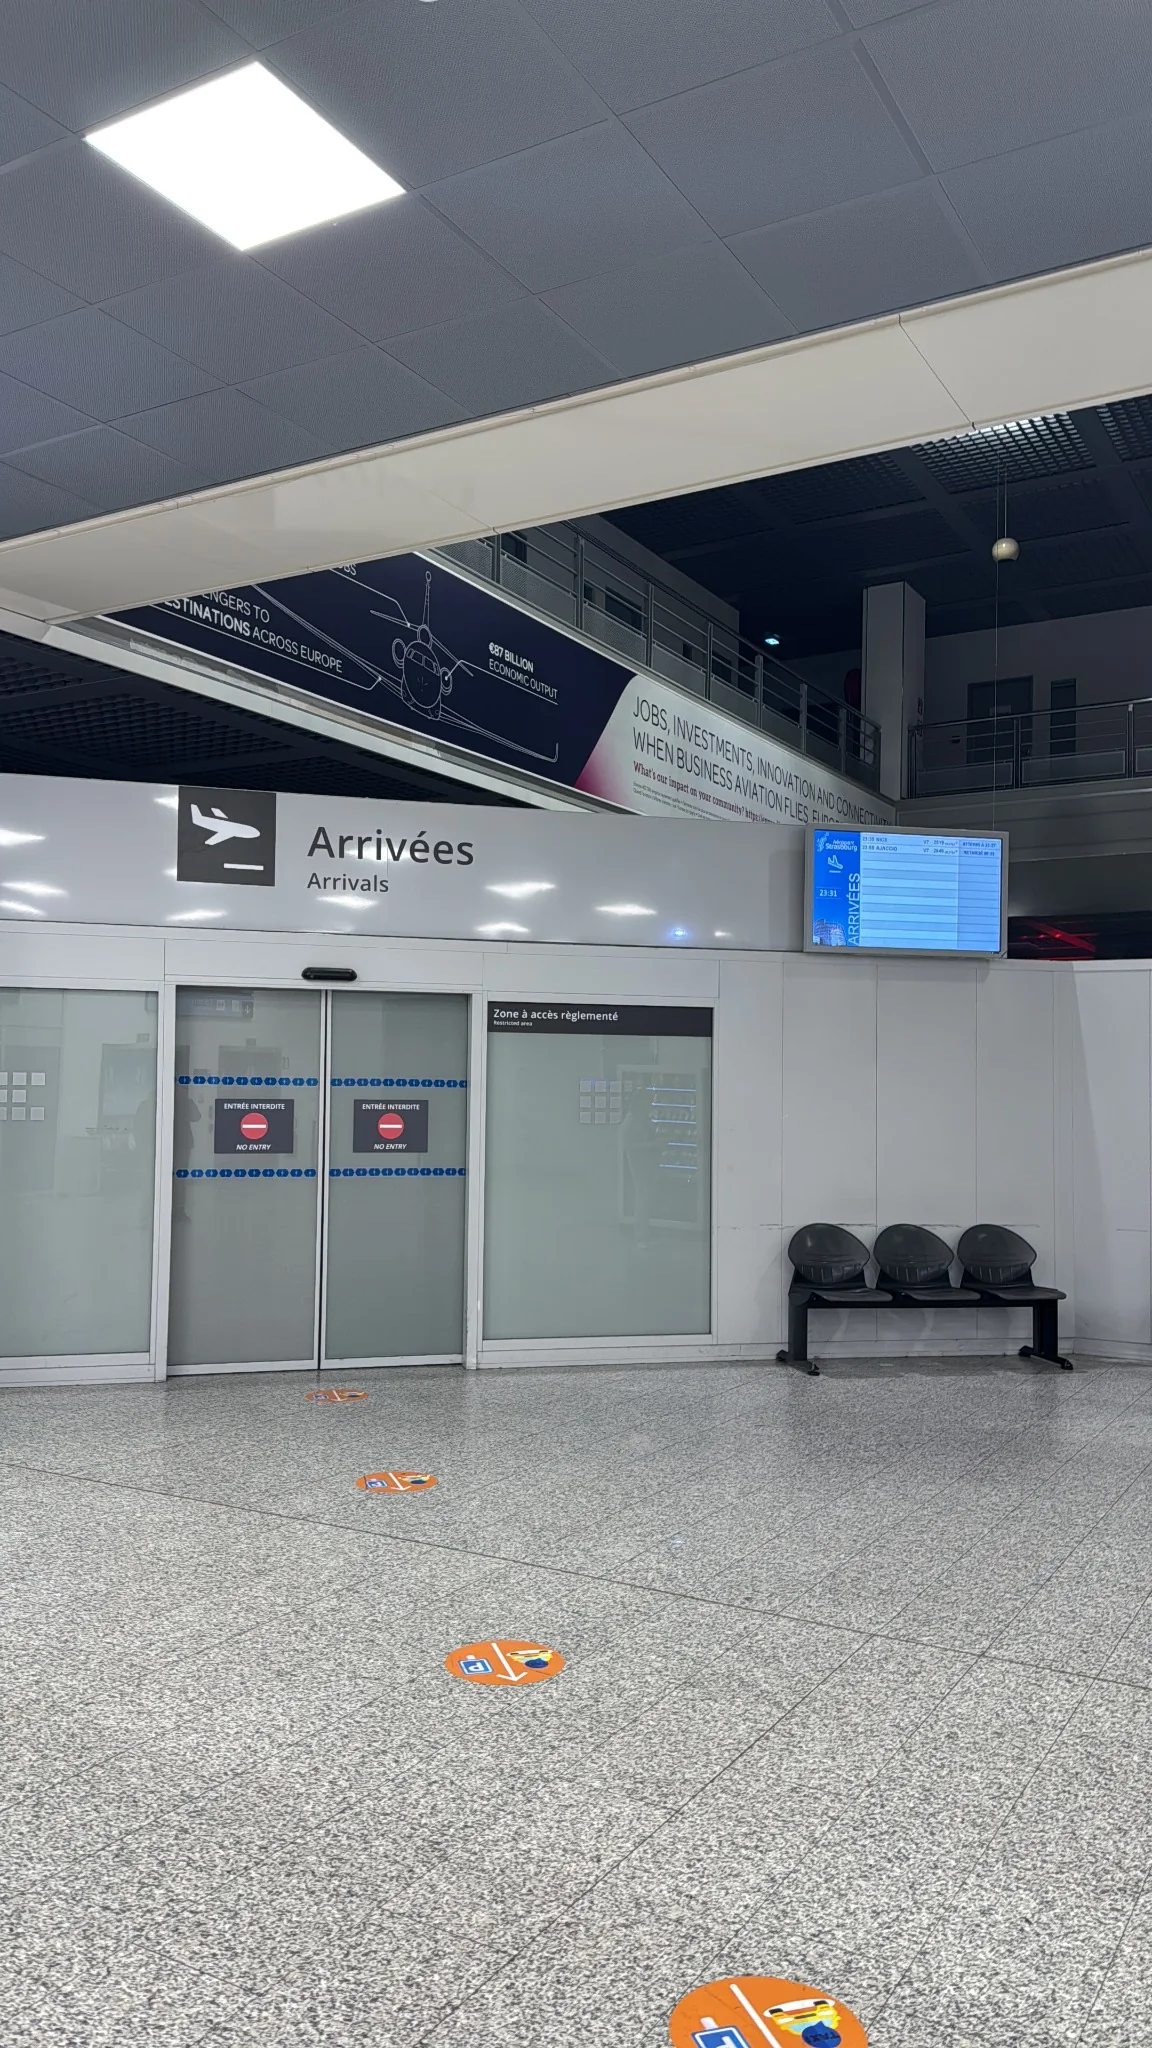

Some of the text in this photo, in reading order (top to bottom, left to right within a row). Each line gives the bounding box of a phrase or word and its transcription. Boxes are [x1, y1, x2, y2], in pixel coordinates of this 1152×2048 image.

[253, 604, 270, 623] TO
[253, 626, 299, 655] ACROSS
[300, 644, 343, 674] EUROPE
[488, 641, 534, 673] €87 BILLION
[489, 658, 558, 699] ECONOMIC OUTPUT
[633, 696, 671, 736] JOBS,
[673, 714, 755, 776] INVESTMENTS,
[757, 756, 816, 801] INNOVATION
[817, 787, 835, 809] AND
[633, 726, 674, 766] WHEN
[676, 747, 733, 791] BUSINESS
[734, 774, 783, 813] AVIATION
[784, 796, 809, 824] FLIES
[633, 760, 656, 780] What's
[656, 773, 668, 785] our
[669, 775, 690, 793] impact
[689, 787, 698, 798] on
[698, 790, 711, 803] your
[712, 796, 745, 817] community?
[307, 826, 474, 866] Arrivées
[825, 842, 858, 852] Strasbourg
[306, 872, 389, 893] Arrivals
[819, 888, 838, 898] 23:31
[846, 872, 861, 946] ARRIVÉES
[493, 1008, 619, 1022] Zone à accès règlementé
[223, 1102, 250, 1110] ENTRÉE
[362, 1102, 420, 1111] ENTRÉE INTERDITE
[236, 1143, 272, 1151] NO ENTRY
